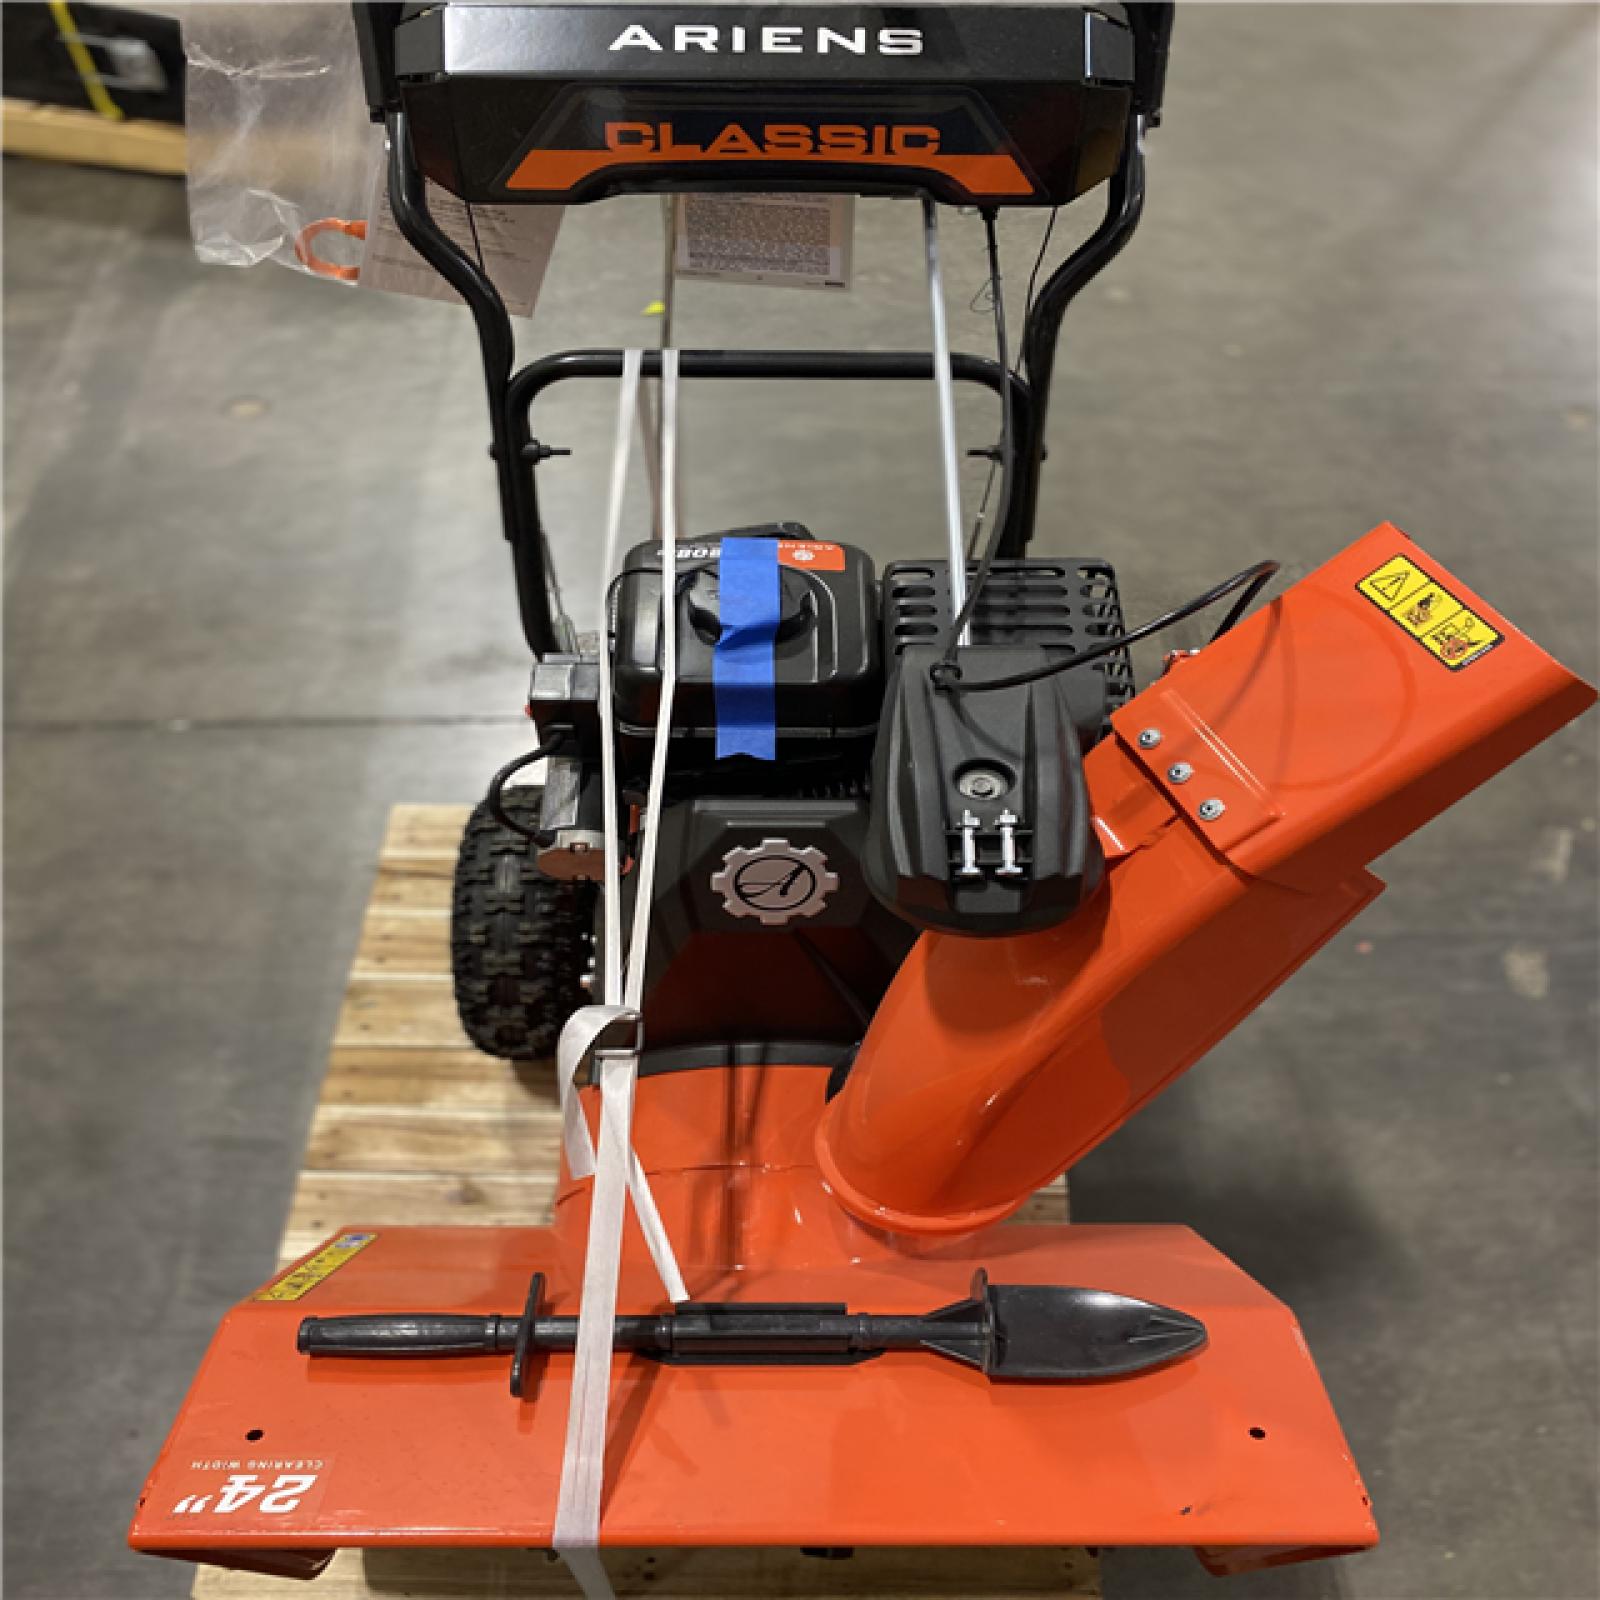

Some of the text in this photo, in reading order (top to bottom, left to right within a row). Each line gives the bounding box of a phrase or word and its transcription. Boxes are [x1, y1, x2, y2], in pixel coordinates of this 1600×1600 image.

[608, 25, 923, 55] ARIENS
[604, 121, 941, 154] CLASSIC
[191, 1459, 324, 1470] CLEARING WIDTH
